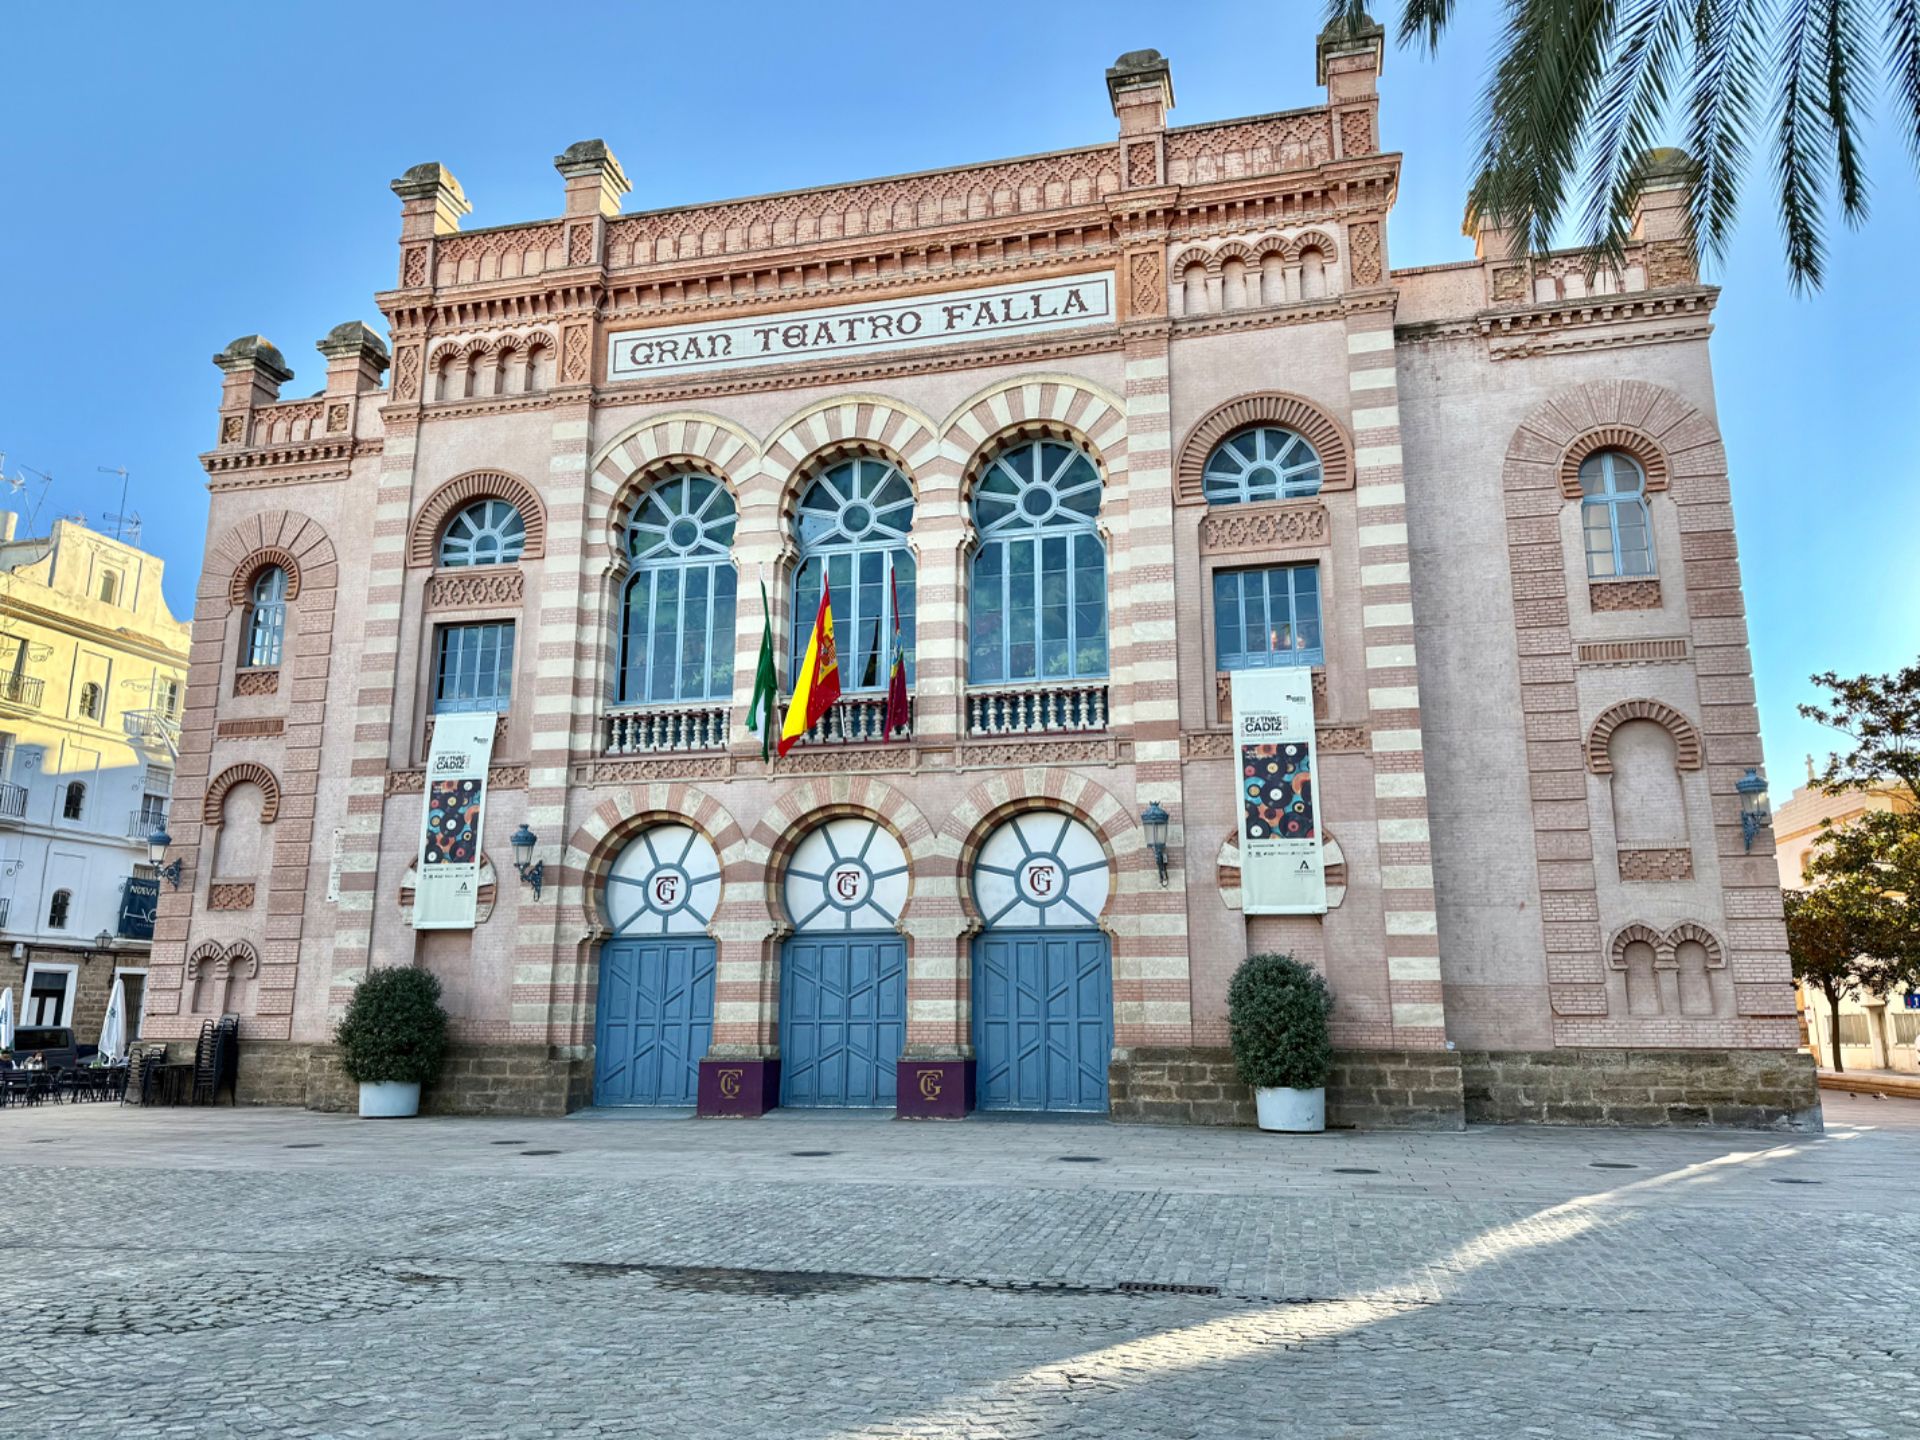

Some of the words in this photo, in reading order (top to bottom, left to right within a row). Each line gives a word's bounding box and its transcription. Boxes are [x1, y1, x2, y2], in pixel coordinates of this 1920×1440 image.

[630, 333, 733, 367] GRAN
[753, 311, 923, 352] TEATRO
[942, 288, 1090, 331] FALLA
[130, 886, 157, 896] NUEVA
